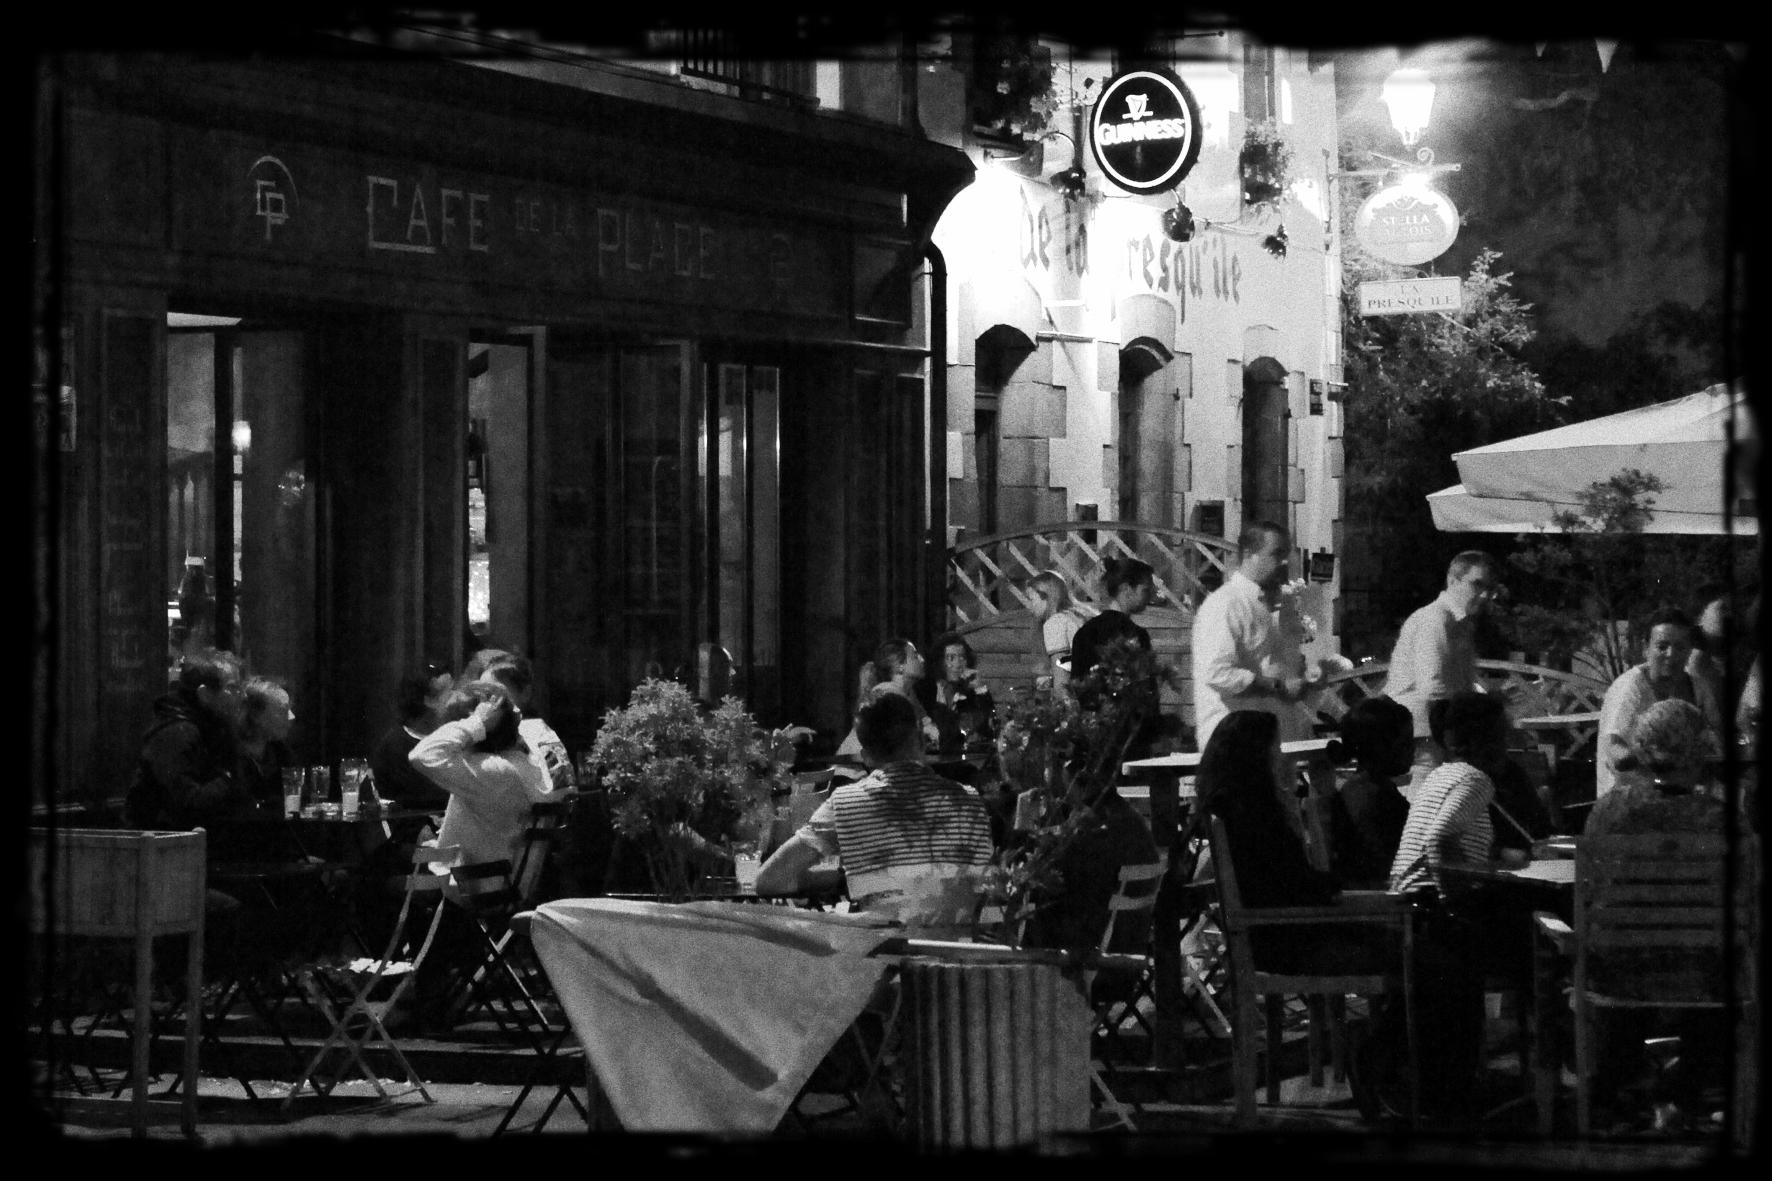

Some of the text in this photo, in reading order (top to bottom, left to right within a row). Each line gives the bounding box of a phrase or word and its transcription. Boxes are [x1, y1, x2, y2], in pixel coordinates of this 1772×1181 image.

[1099, 118, 1185, 146] GUINNESS
[366, 174, 491, 255] CAFE
[514, 197, 541, 233] DE
[596, 207, 718, 281] PLACE
